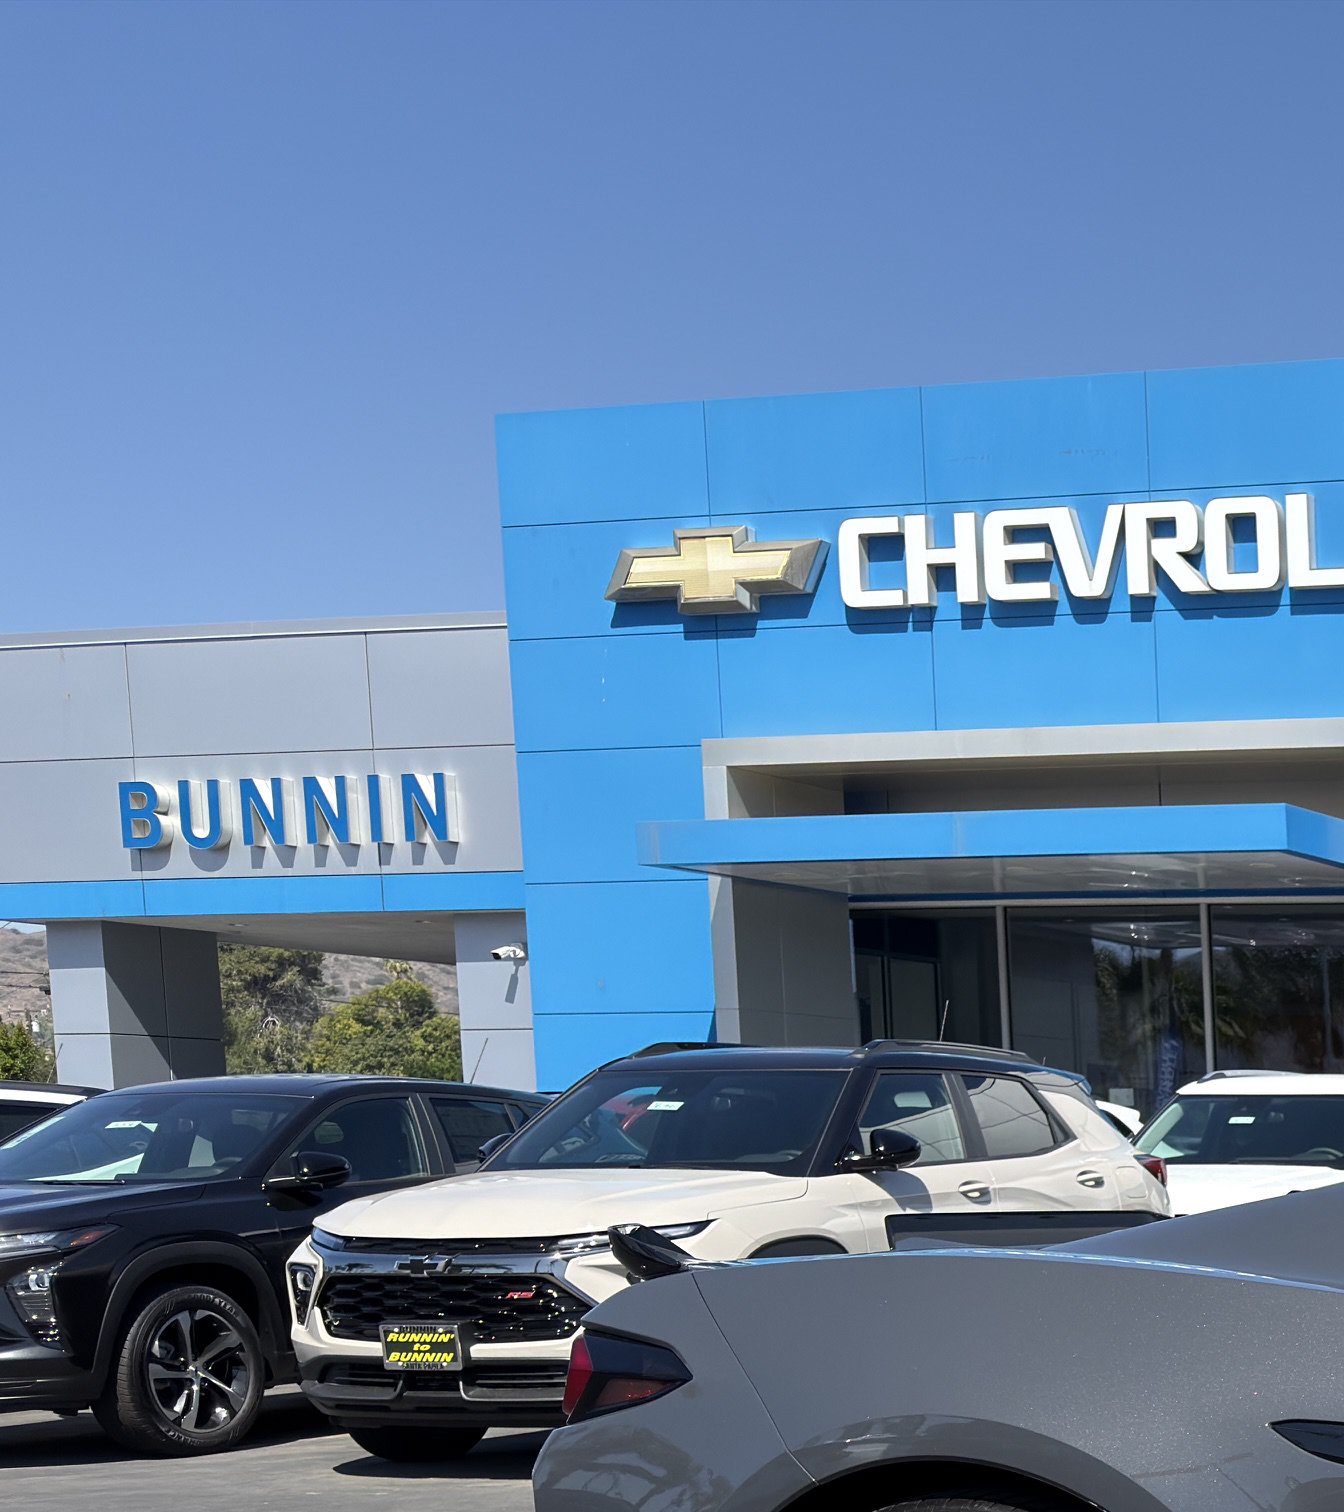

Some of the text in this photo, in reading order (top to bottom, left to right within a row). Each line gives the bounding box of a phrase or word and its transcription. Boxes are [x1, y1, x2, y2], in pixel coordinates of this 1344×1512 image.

[118, 772, 454, 850] BUNNIN
[386, 1332, 455, 1343] RUNNIN'
[412, 1342, 431, 1351] to
[388, 1352, 455, 1363] BUNNIN
